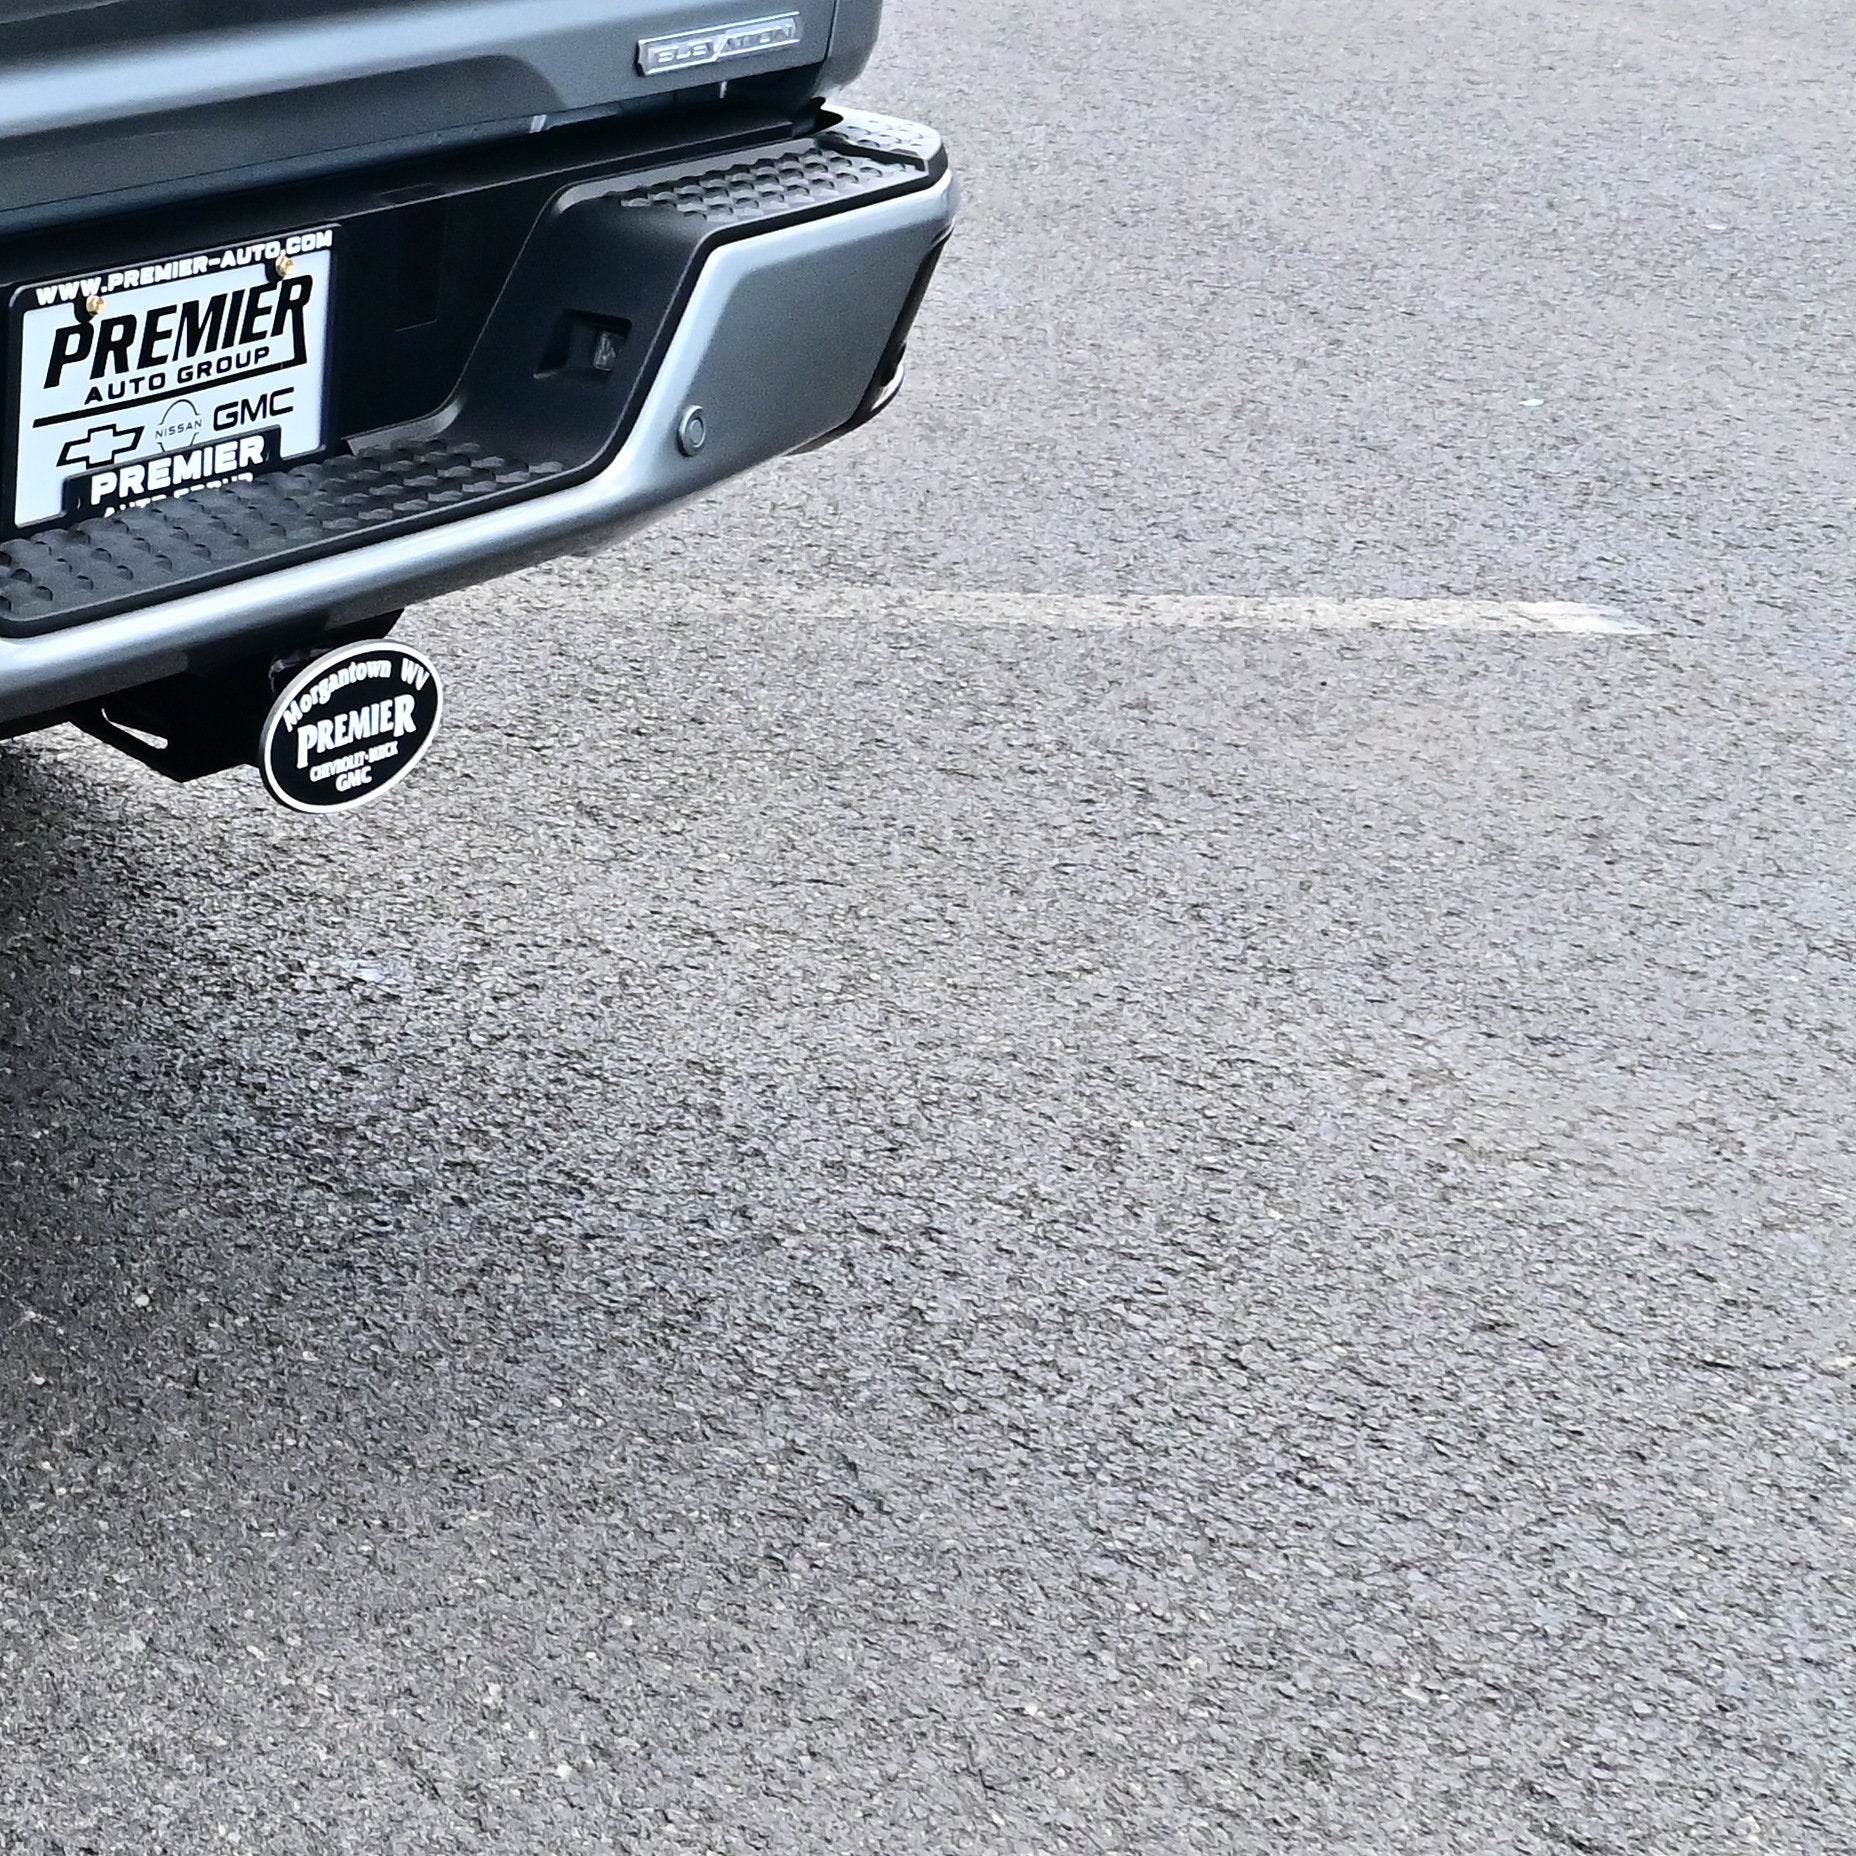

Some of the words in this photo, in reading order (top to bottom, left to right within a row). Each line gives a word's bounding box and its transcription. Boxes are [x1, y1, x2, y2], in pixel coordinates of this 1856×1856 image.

[42, 273, 314, 390] PREMIER
[84, 371, 166, 405] AUTO
[176, 346, 270, 384] GROUP
[154, 418, 203, 440] NISSAN
[213, 386, 295, 432] GMC
[89, 434, 265, 507] PREMIER
[282, 659, 392, 733] Morgantown
[400, 657, 430, 691] WV
[296, 693, 417, 770] PREMIER
[335, 765, 373, 793] GMC
